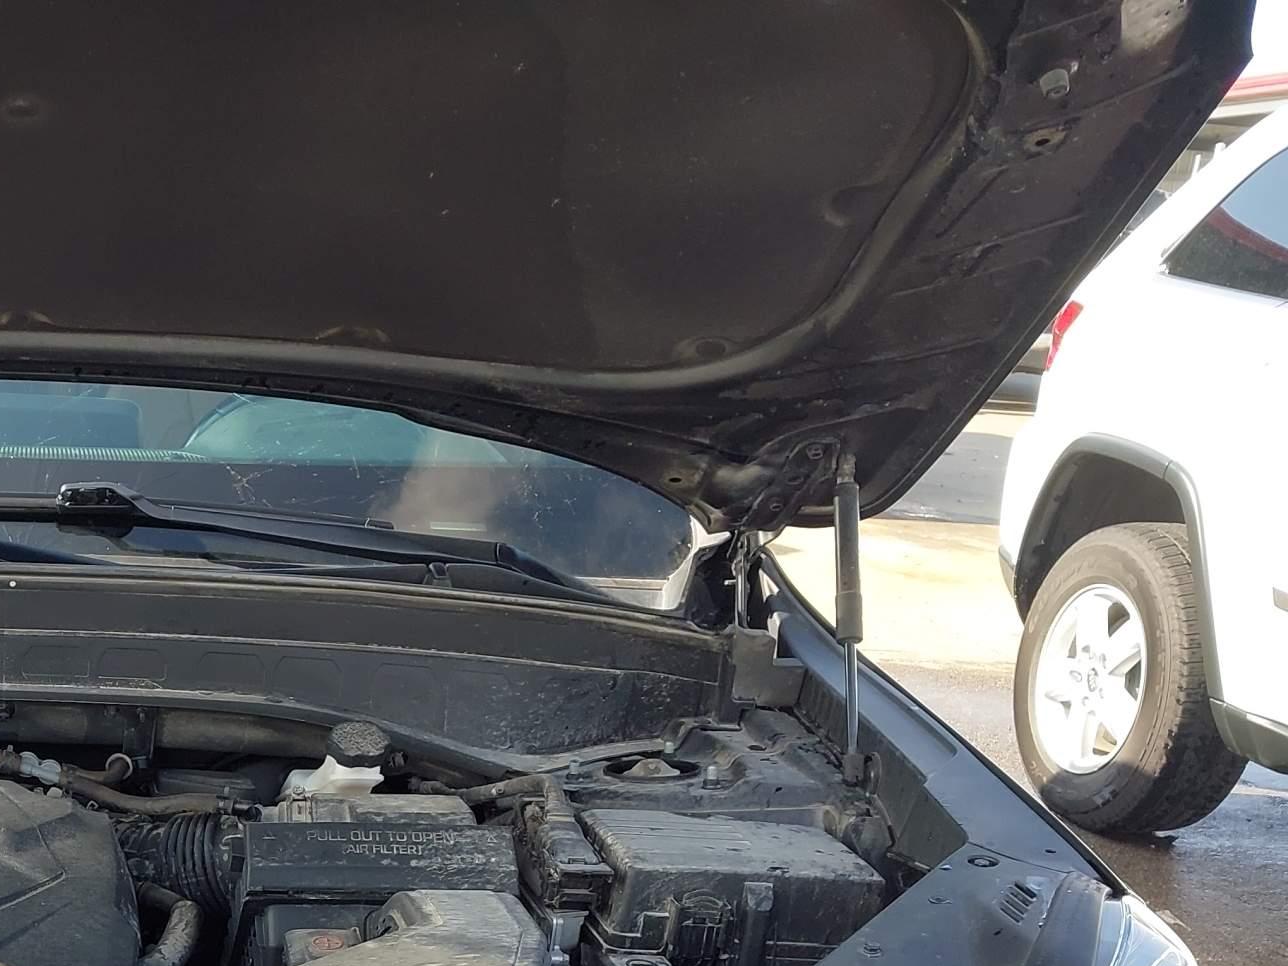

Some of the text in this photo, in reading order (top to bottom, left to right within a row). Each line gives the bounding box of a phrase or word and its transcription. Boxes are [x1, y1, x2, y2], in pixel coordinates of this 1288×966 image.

[306, 830, 455, 845] PULL OUT TO OPEN
